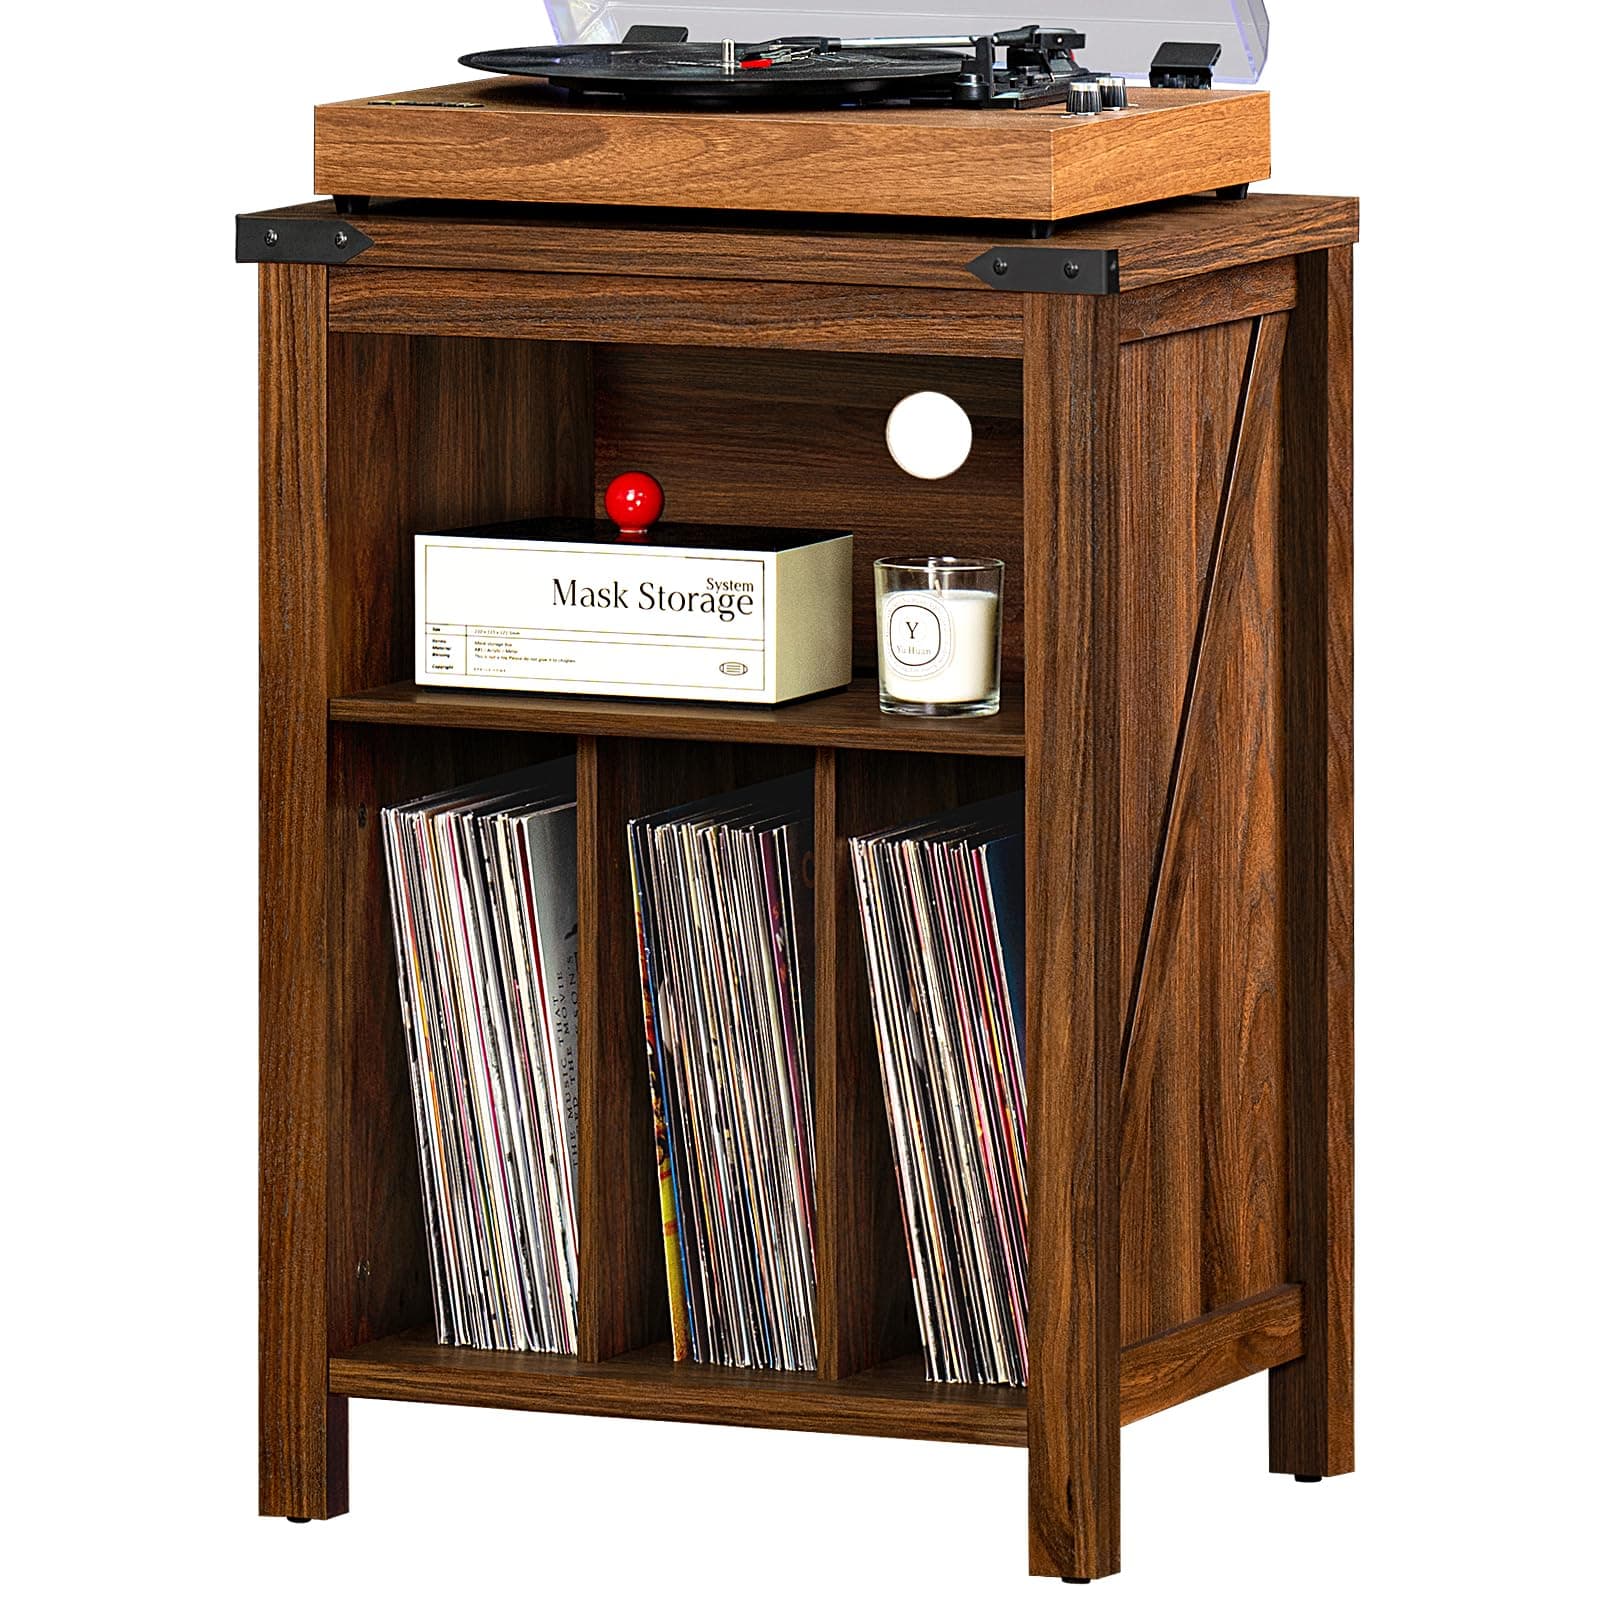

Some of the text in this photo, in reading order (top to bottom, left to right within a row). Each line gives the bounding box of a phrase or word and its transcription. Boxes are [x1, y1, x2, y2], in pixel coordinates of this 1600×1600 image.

[552, 578, 754, 622] Mask Storage
[706, 577, 754, 594] System
[905, 621, 919, 639] Y
[552, 996, 564, 1046] THAT
[556, 971, 570, 1034] MOVIE
[566, 1046, 576, 1086] THE
[561, 1058, 574, 1120] MUSIC
[570, 1130, 578, 1168] THE
